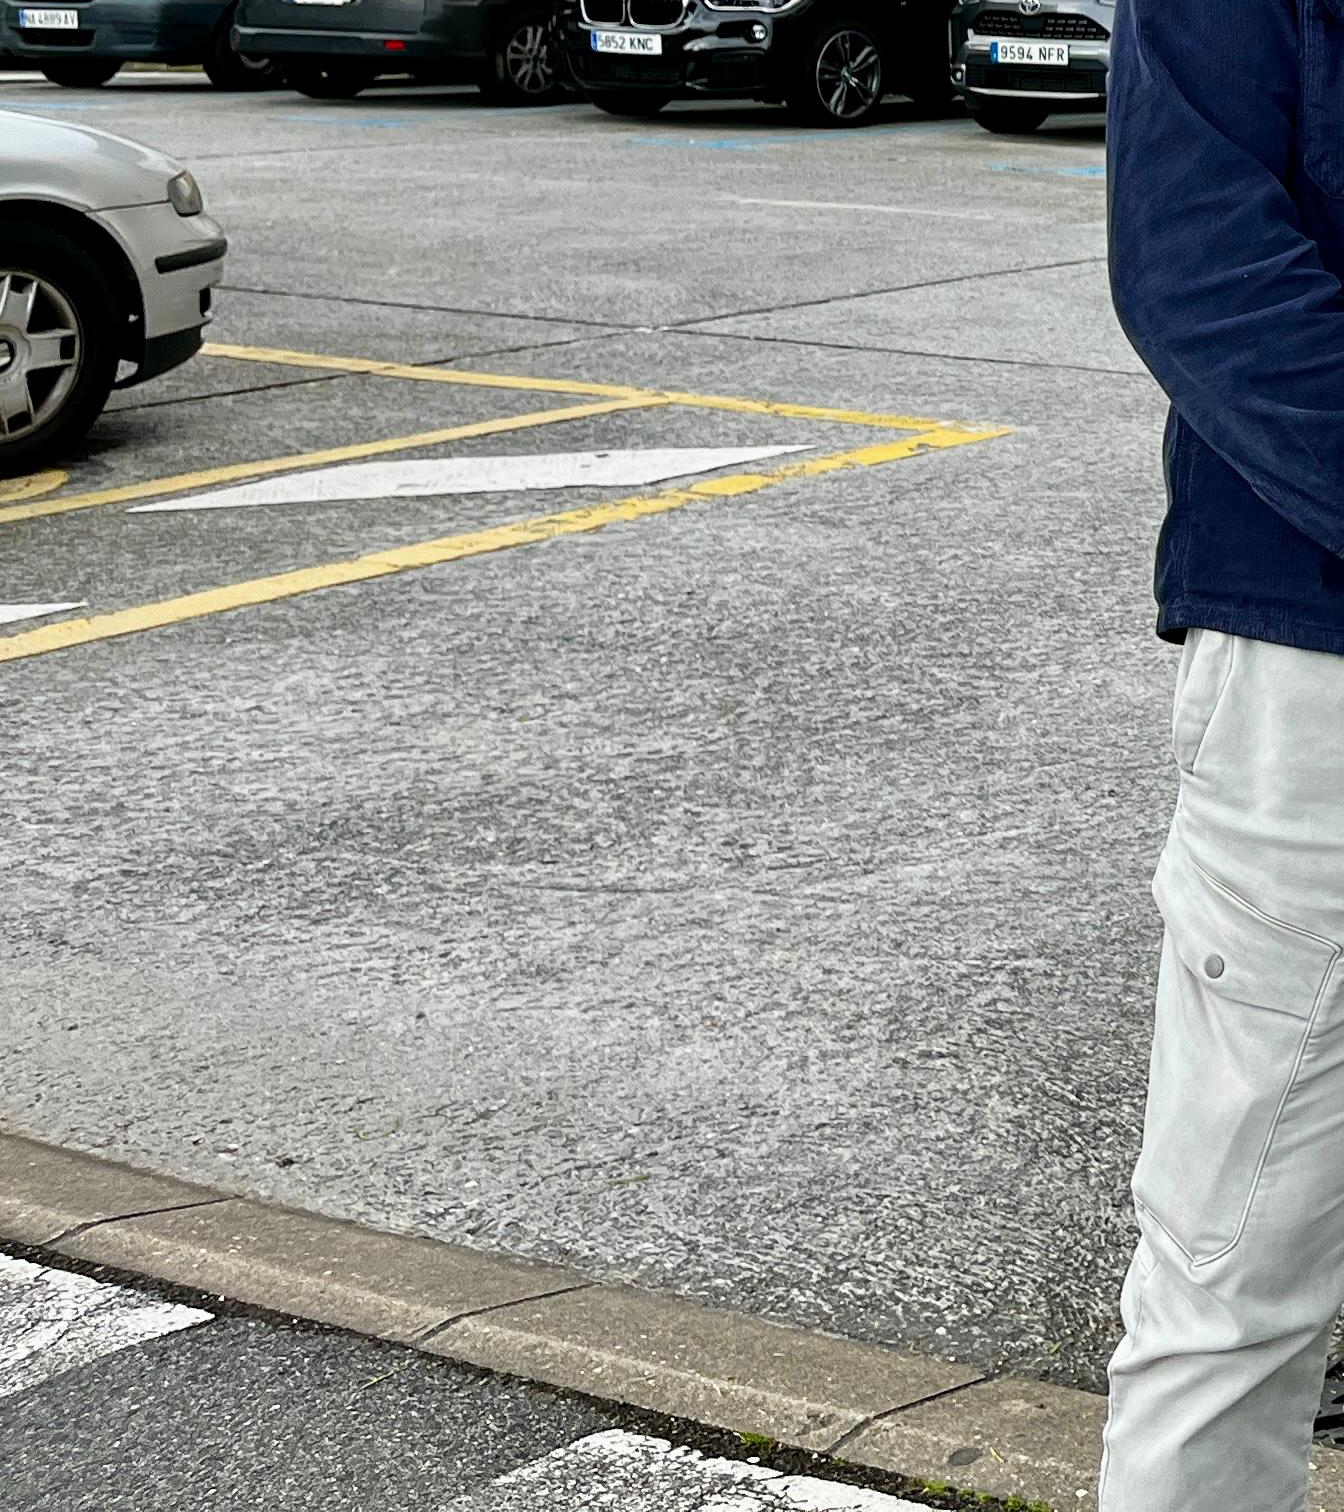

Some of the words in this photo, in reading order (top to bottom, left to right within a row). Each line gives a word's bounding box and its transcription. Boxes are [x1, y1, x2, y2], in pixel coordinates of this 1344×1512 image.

[629, 37, 654, 51] KNC
[1000, 45, 1033, 60] 9594
[1038, 46, 1065, 62] NFR
